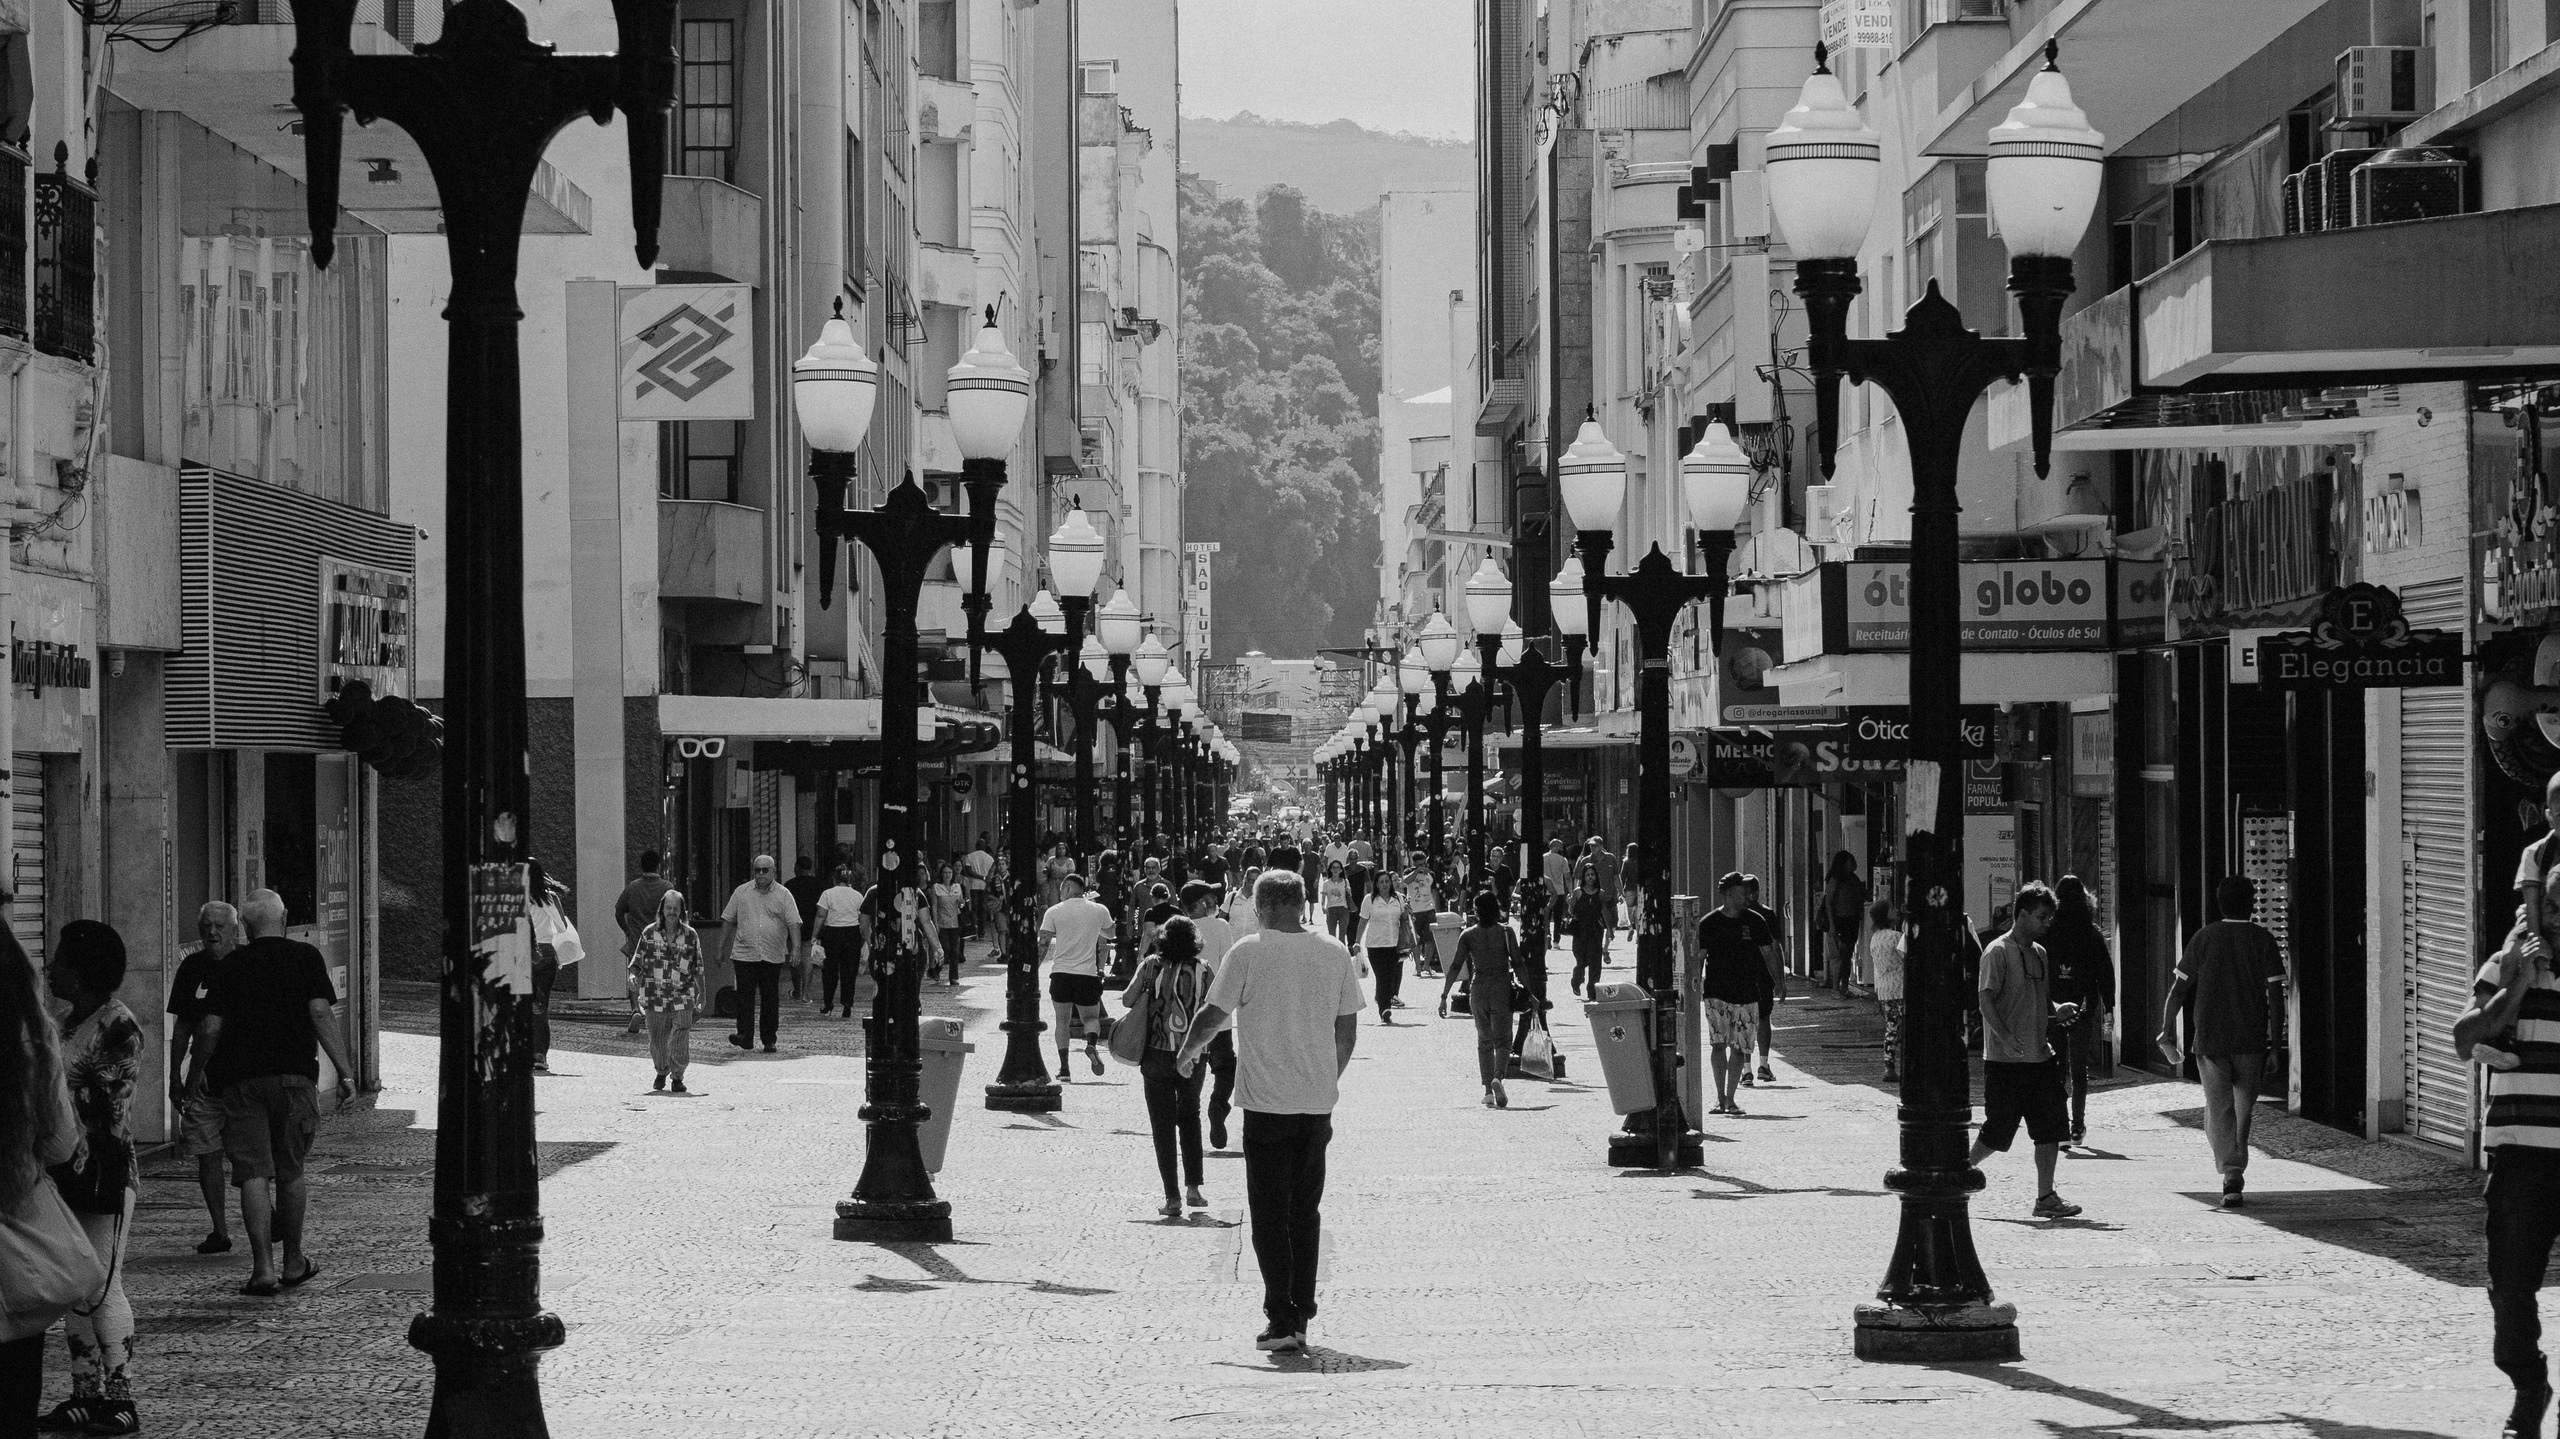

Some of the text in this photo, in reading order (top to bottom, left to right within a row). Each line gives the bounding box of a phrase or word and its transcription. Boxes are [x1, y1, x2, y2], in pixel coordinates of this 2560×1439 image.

[1824, 17, 1847, 40] VENDE
[1186, 543, 1219, 551] HOTEL
[1976, 570, 2092, 616] globo
[2350, 600, 2373, 631] E
[1199, 607, 1209, 658] LUIZ
[1855, 627, 1911, 642] Receituári
[1961, 628, 1975, 640] de
[1978, 628, 2019, 640] Contato
[2027, 624, 2065, 640] Óculos
[2067, 627, 2082, 640] de
[2083, 626, 2101, 639] Sol
[2279, 651, 2445, 684] Elegância
[1747, 707, 1828, 719] @drogariasouzajf
[1816, 741, 1906, 773] Souz
[954, 779, 970, 787] OTK
[1967, 781, 2002, 795] FARMÁC
[1101, 791, 1114, 800] DE
